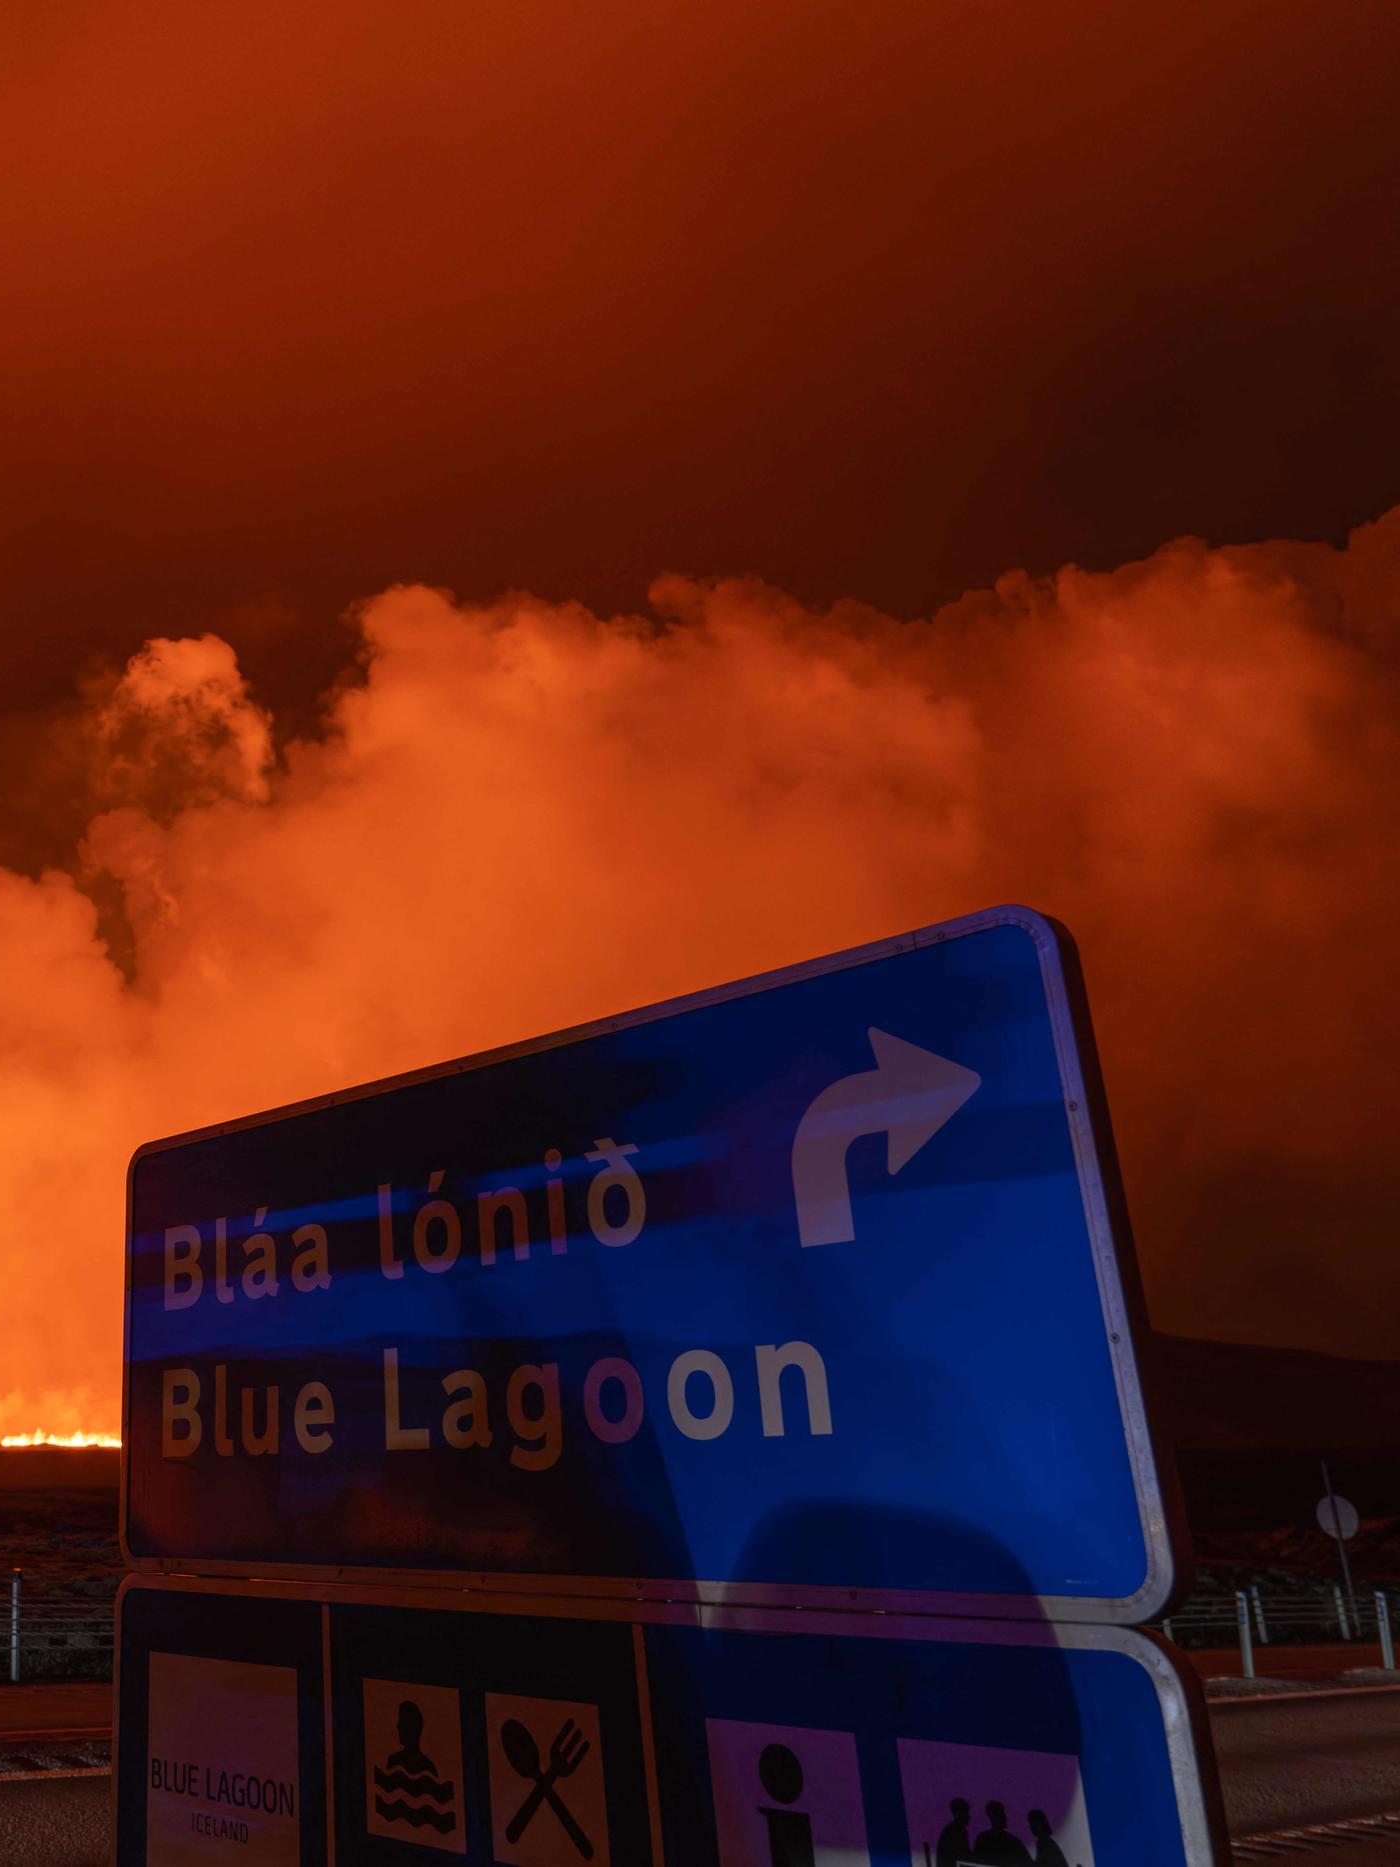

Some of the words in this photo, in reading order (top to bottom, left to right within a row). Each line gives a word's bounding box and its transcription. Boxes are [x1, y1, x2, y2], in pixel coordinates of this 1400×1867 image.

[164, 1208, 331, 1311] Bláa
[377, 1137, 647, 1280] lónið
[162, 1365, 334, 1458] Blue
[383, 1339, 833, 1470] Lagoon
[151, 1758, 199, 1797] BLUE
[206, 1767, 294, 1817] LAGOON
[191, 1813, 248, 1844] ICELAND
